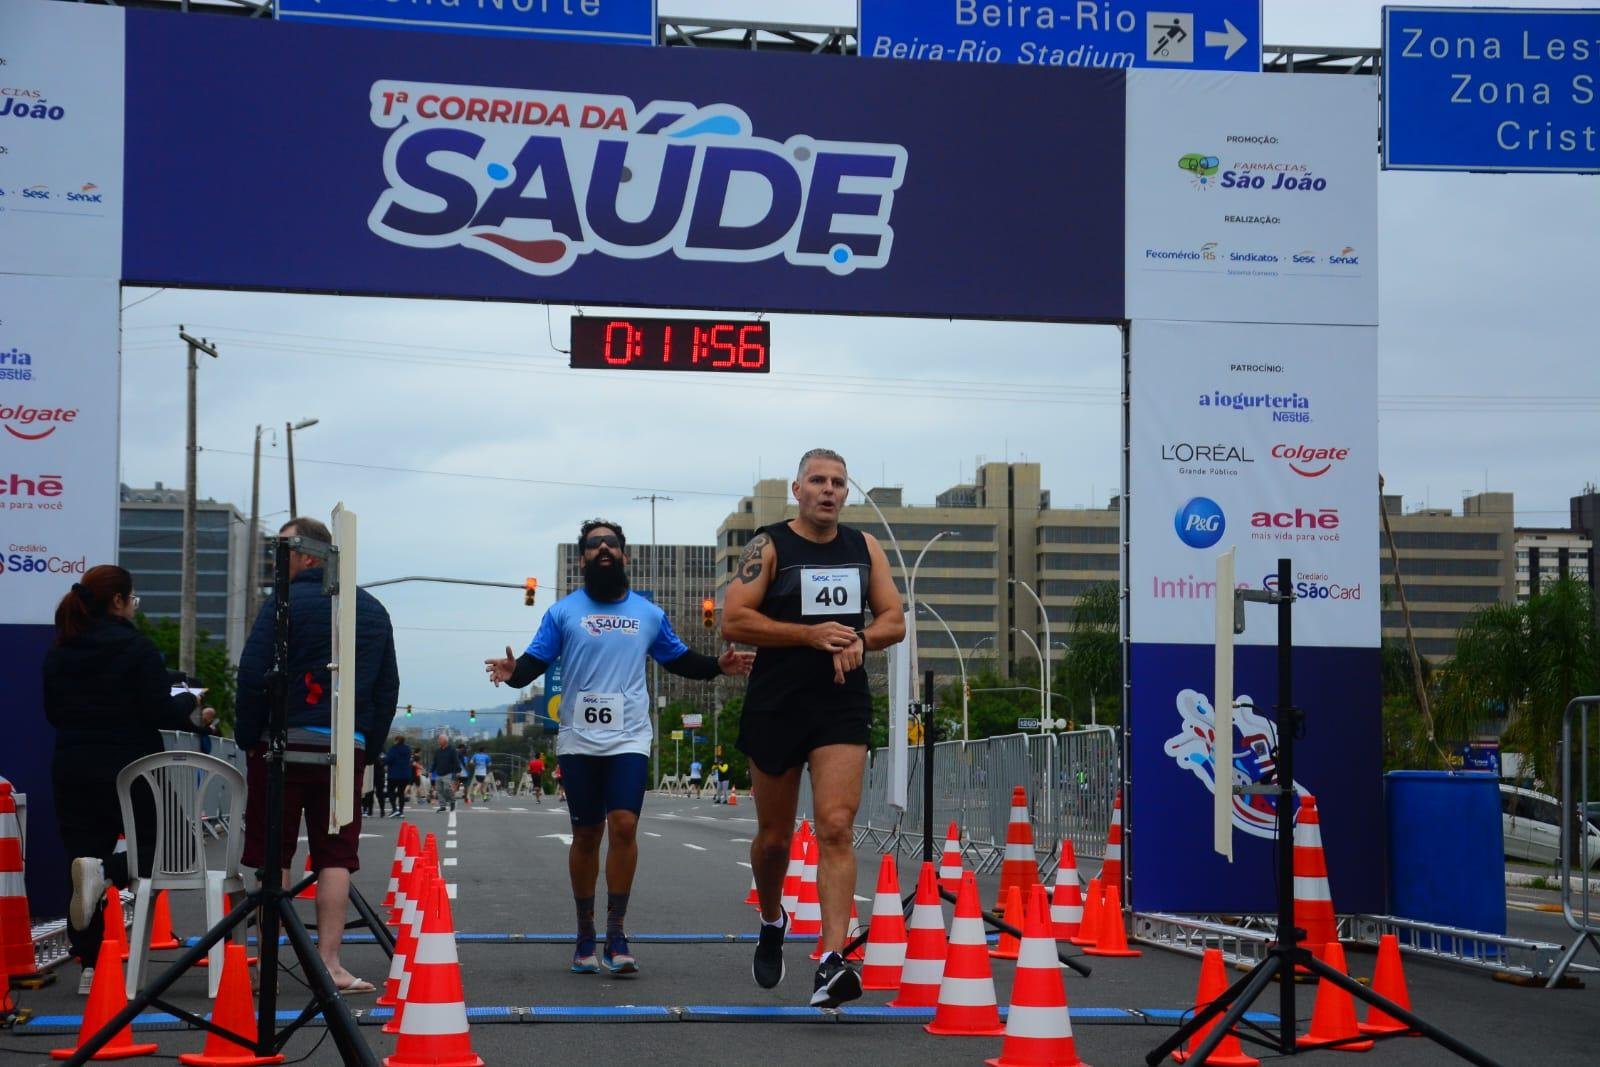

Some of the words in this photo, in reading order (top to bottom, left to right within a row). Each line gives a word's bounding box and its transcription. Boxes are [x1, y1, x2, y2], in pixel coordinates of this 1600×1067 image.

[955, 0, 1136, 33] Beira-Rio
[872, 36, 1001, 64] Beira-Rio
[1018, 42, 1136, 68] Stadium
[1402, 28, 1500, 59] Zona
[1523, 30, 1600, 61] Les
[1451, 74, 1549, 104] Zona
[416, 94, 571, 128] CORRIDA
[579, 105, 629, 132] DA
[1226, 135, 1280, 145] PROMOÇÃO:
[1496, 121, 1596, 151] Crist
[1233, 162, 1308, 172] FARMÁCIAS
[381, 112, 897, 258] SAÚDE
[1220, 171, 1265, 189] São
[1271, 172, 1327, 191] João
[1224, 215, 1281, 225] REALIZAÇÃO:
[1230, 252, 1278, 263] Sindicatos
[604, 321, 765, 367] 0:11:56
[1230, 363, 1285, 373] PATROCÍNIO:
[1199, 393, 1210, 406] a
[1214, 391, 1309, 410] iogurteria
[0, 404, 76, 424] olgate
[1271, 444, 1348, 463] Colgate
[1179, 467, 1207, 476] Grande
[1210, 467, 1238, 476] Público
[10, 502, 33, 510] para
[1185, 514, 1222, 532] P&G
[1251, 532, 1271, 540] mais
[1275, 532, 1293, 541] vida
[1296, 534, 1315, 543] para
[1319, 533, 1340, 542] você
[8, 555, 85, 574] SãoCard
[816, 586, 848, 606] 40
[1153, 574, 1250, 600] Intim
[1296, 582, 1361, 600] SãoCard
[585, 706, 612, 724] 66
